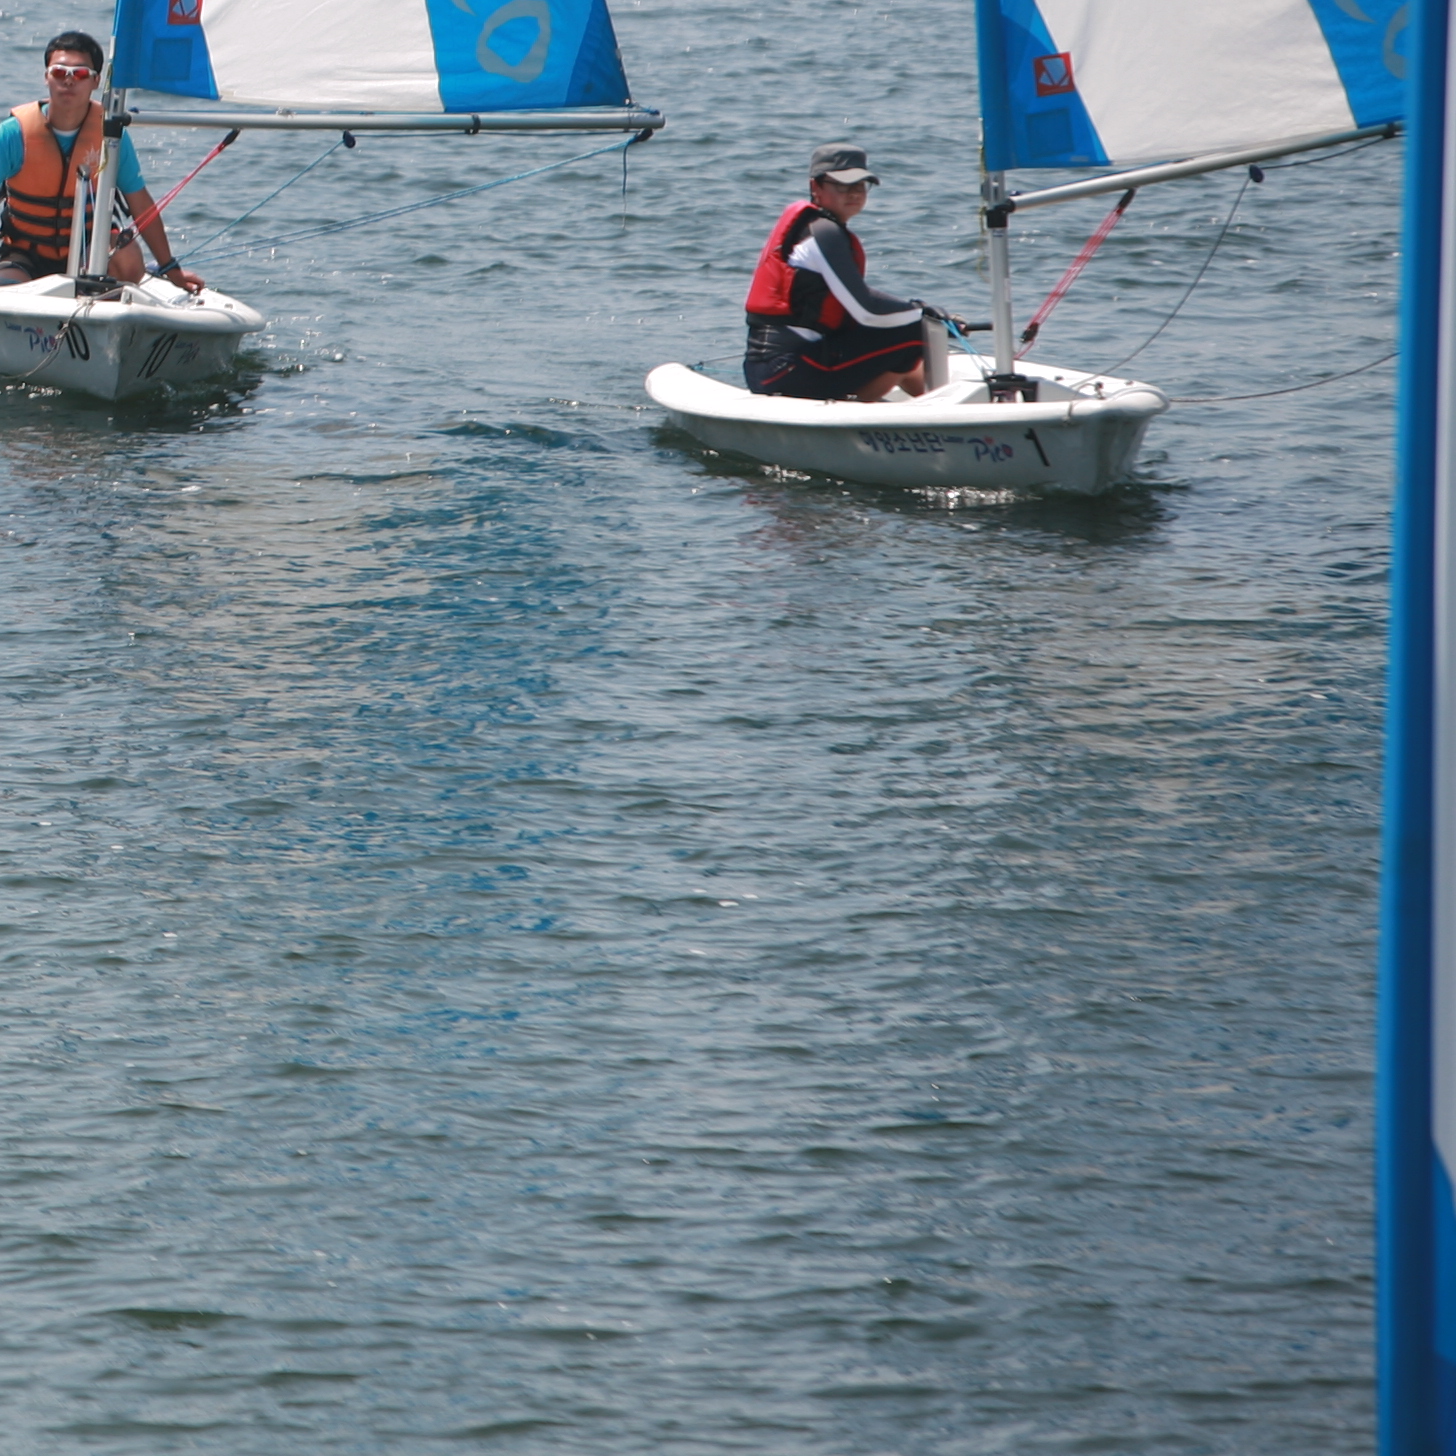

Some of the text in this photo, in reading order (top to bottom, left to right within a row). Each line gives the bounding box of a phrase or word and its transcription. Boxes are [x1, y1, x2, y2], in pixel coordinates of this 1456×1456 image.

[57, 320, 91, 361] 10
[137, 332, 178, 379] 10
[966, 435, 1014, 463] Pico
[1024, 427, 1051, 467] 1
